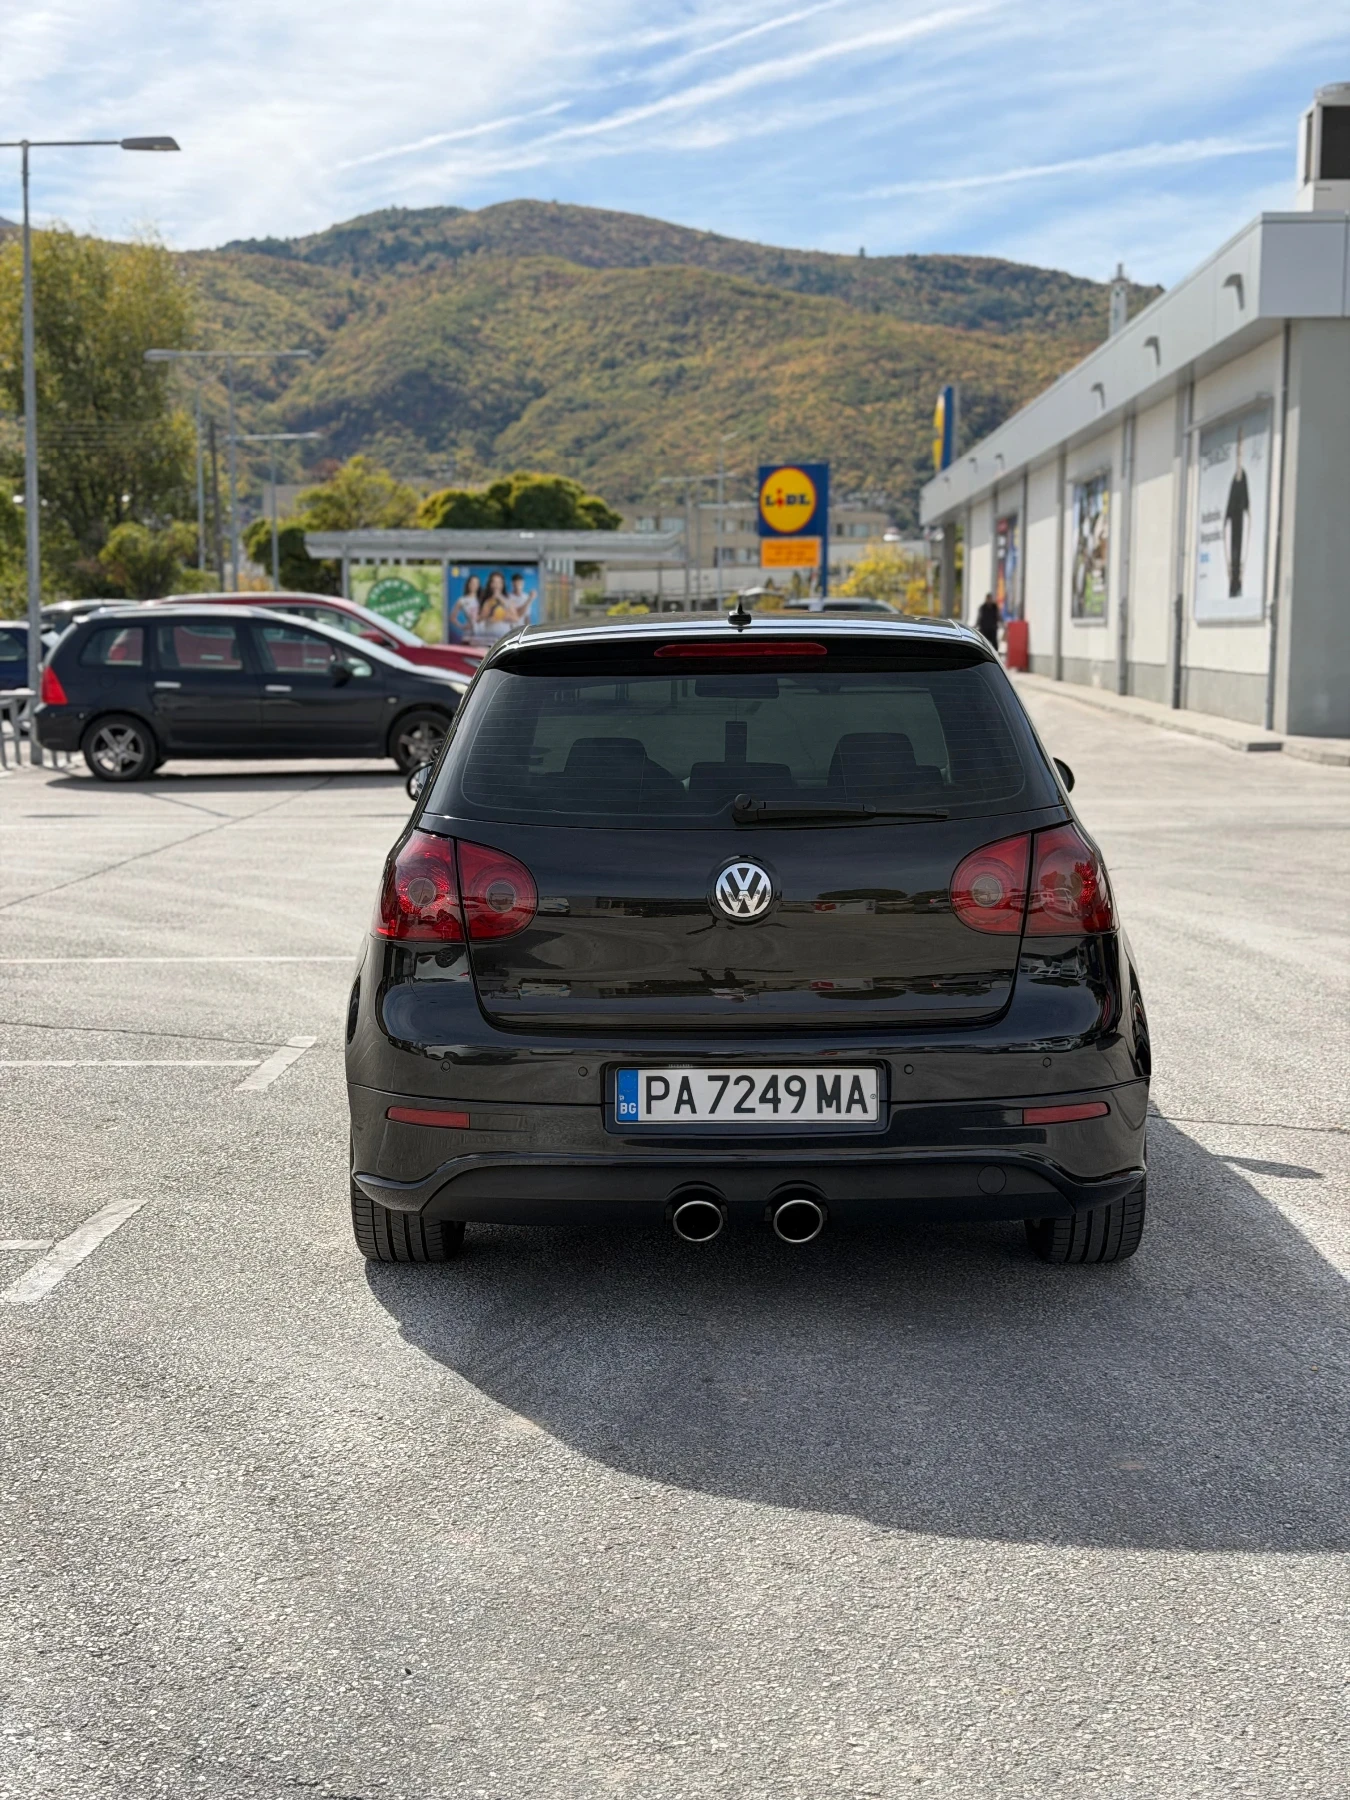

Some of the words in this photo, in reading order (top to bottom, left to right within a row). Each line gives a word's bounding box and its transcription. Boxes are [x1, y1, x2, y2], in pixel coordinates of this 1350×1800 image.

[716, 863, 772, 917] VW
[620, 1103, 637, 1114] BG
[646, 1076, 697, 1114] PA
[708, 1075, 807, 1114] 7249
[816, 1075, 868, 1114] MA
